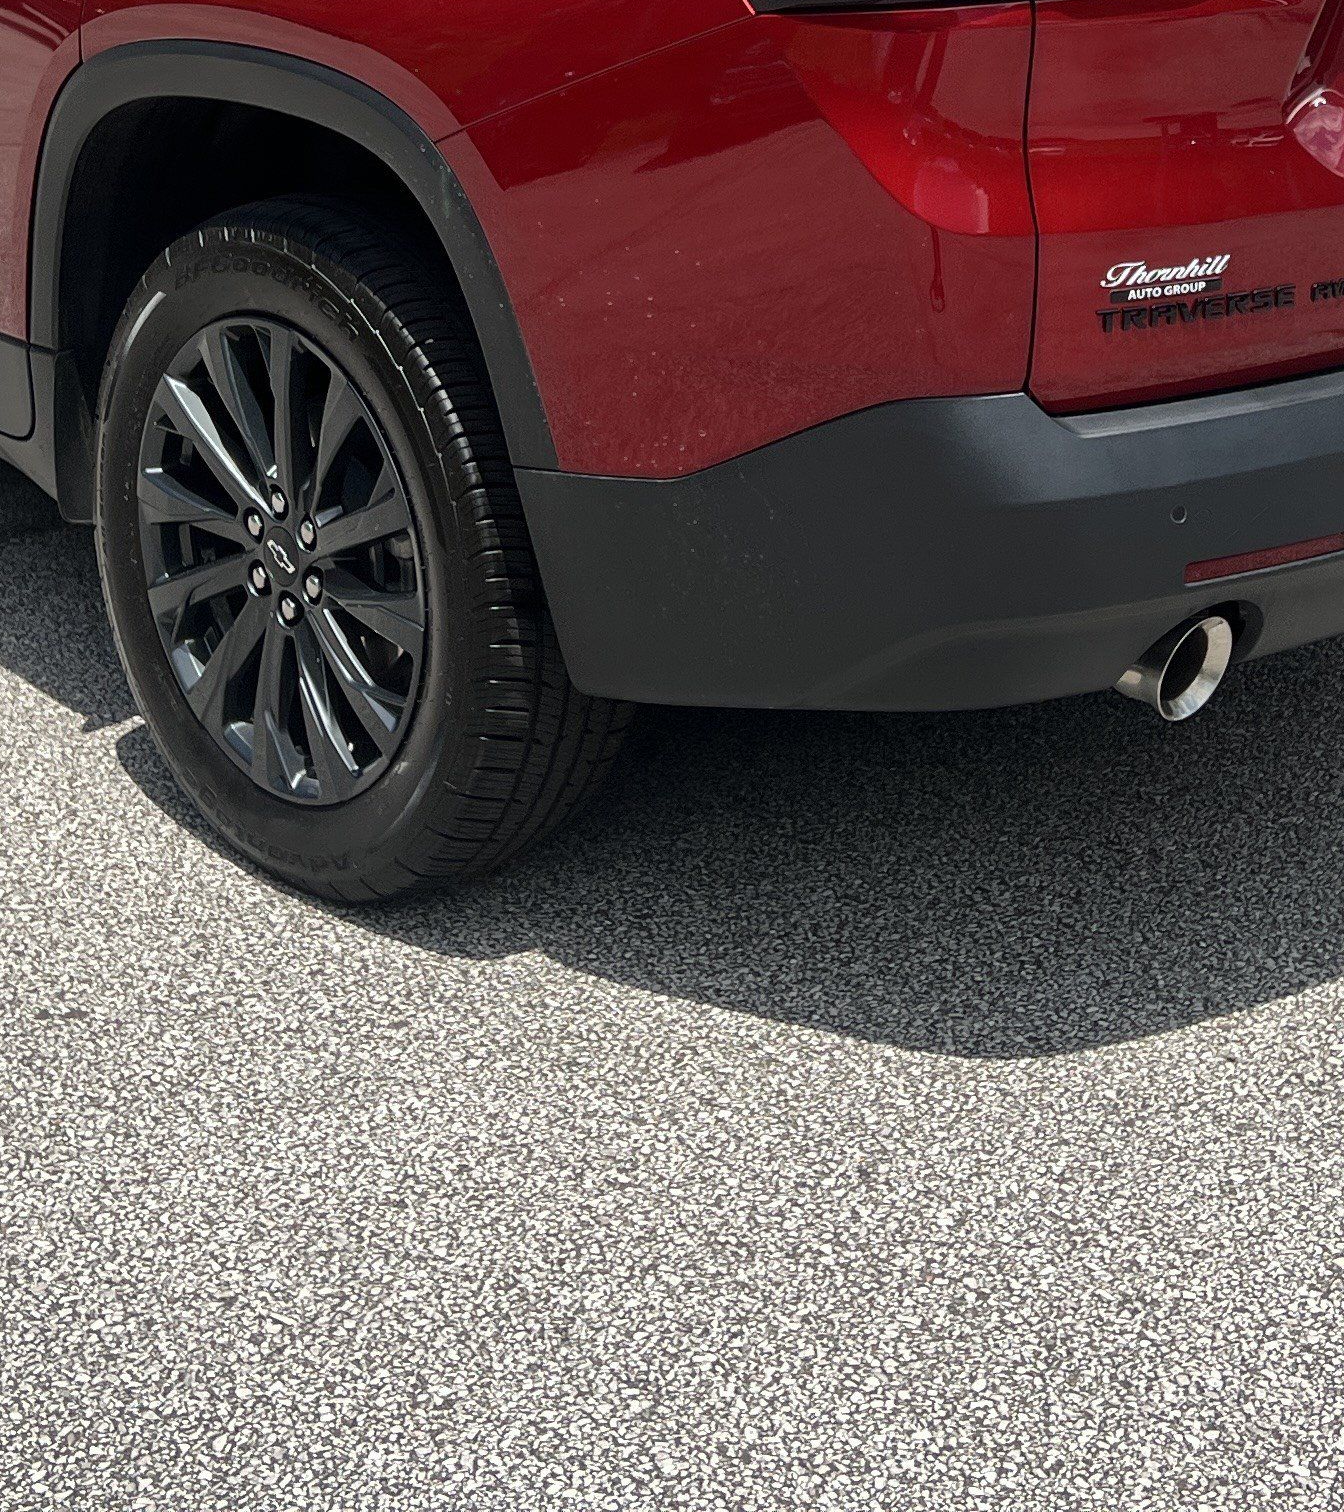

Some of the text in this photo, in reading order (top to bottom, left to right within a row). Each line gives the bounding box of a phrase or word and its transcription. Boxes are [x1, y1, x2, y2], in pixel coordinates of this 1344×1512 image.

[1100, 254, 1231, 288] Thornhill
[1127, 281, 1207, 301] AUTO GROUP
[1095, 283, 1297, 334] TRAVERSE
